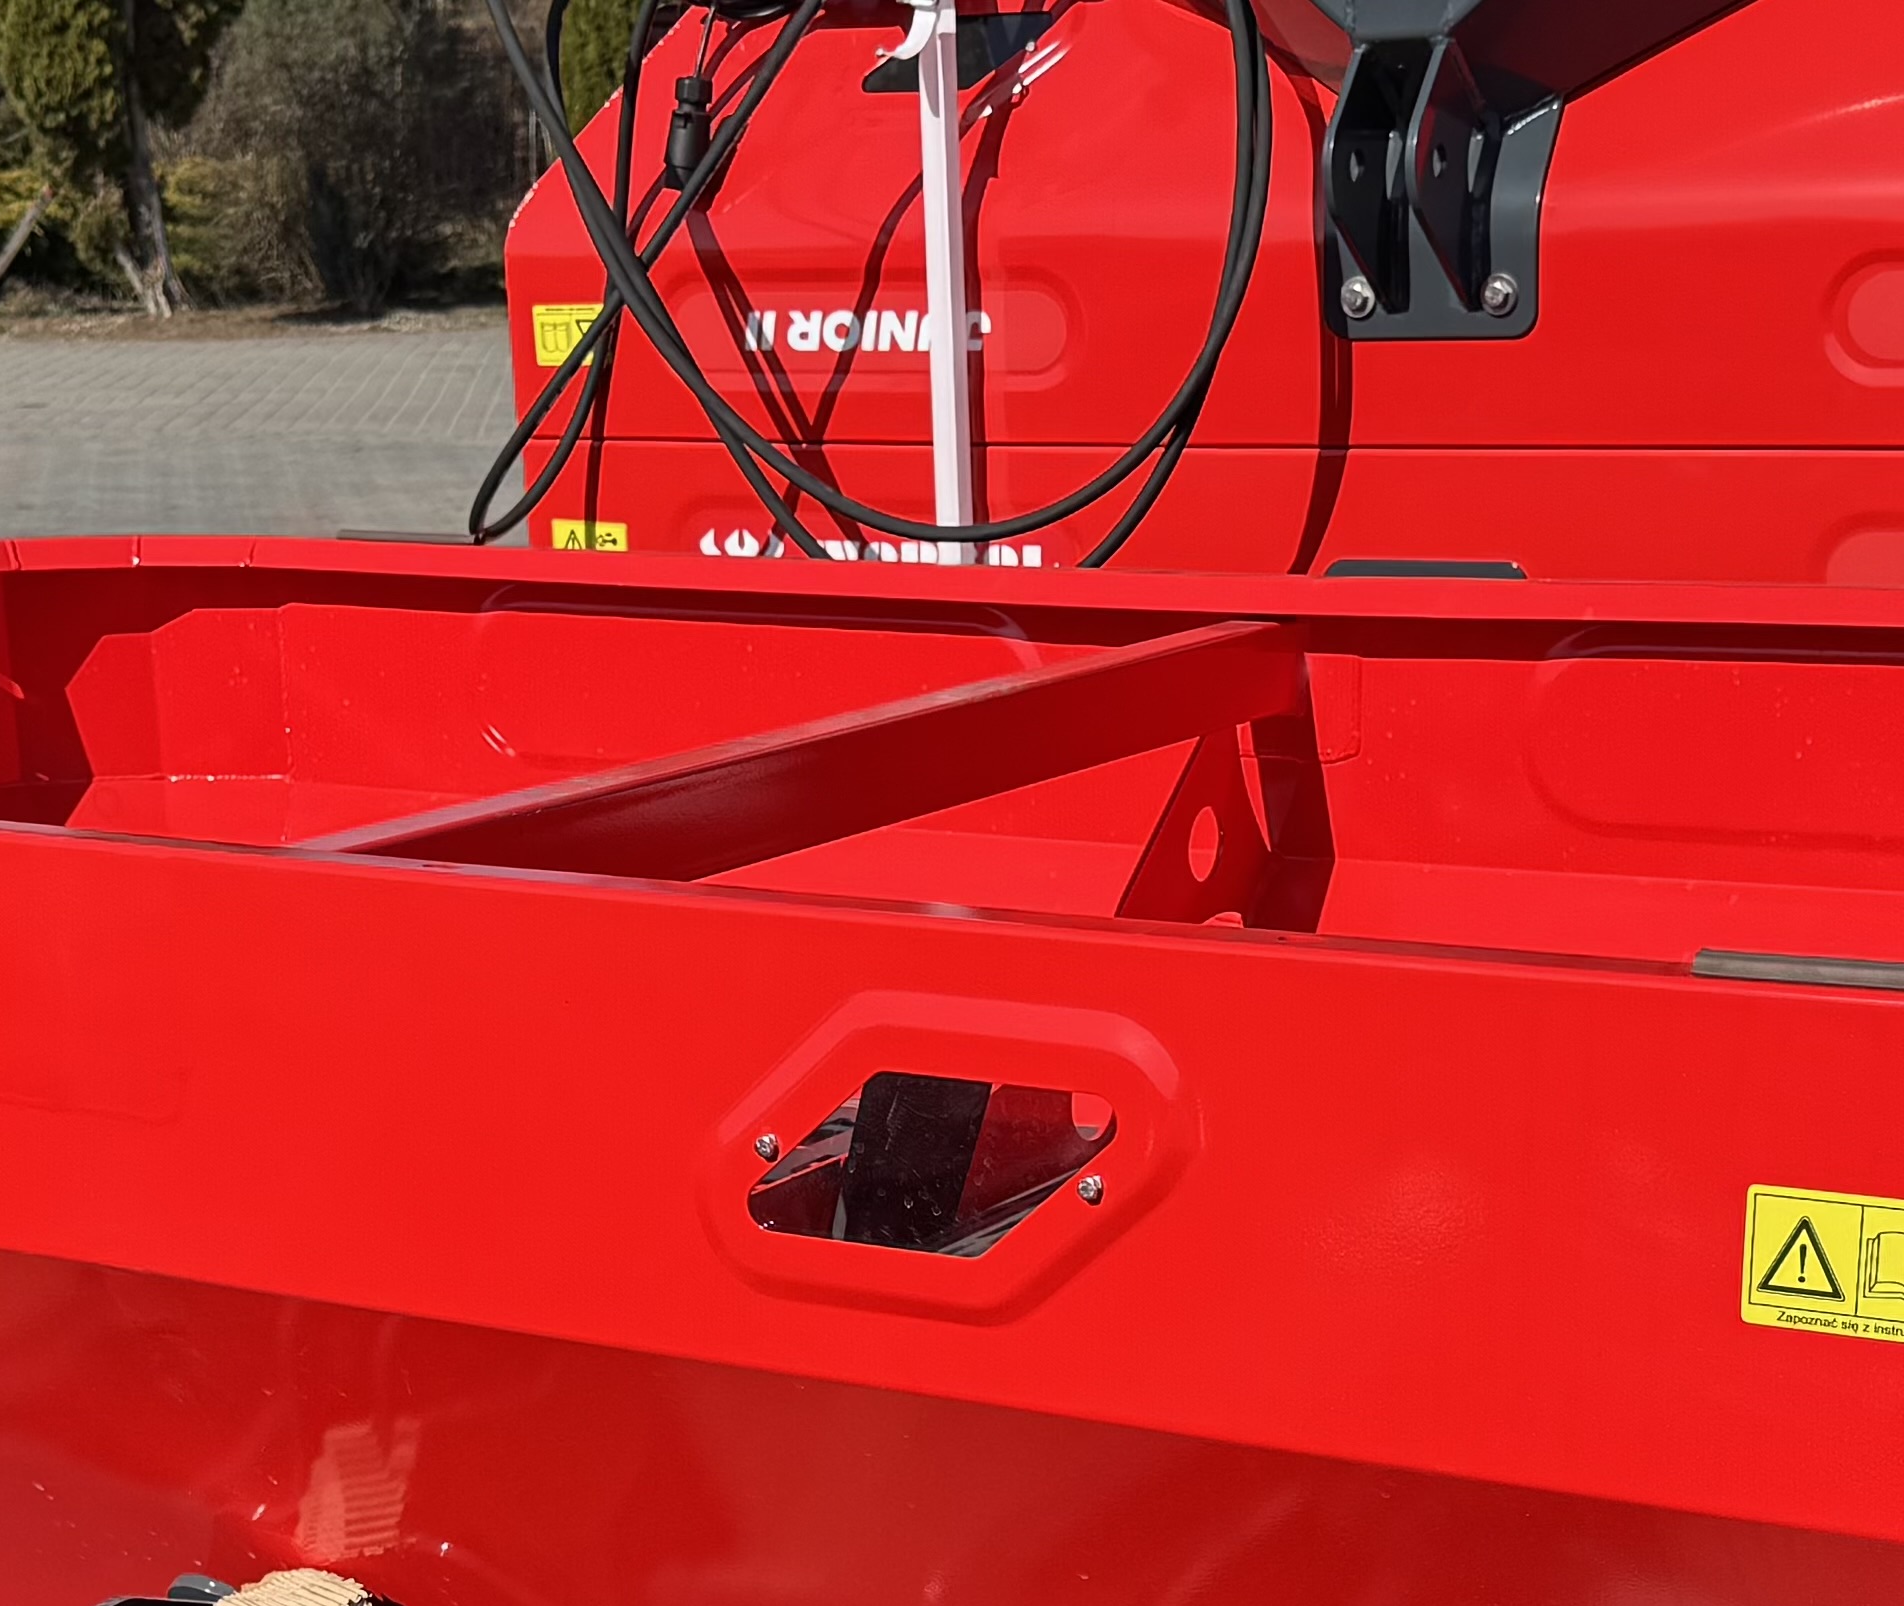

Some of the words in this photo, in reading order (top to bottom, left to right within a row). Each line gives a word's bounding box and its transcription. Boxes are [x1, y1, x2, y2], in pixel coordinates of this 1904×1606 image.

[745, 310, 777, 352] II
[787, 310, 992, 352] JNIOR
[1776, 1311, 1837, 1329] Zapoznać
[1841, 1317, 1859, 1333] się
[1862, 1324, 1870, 1333] z
